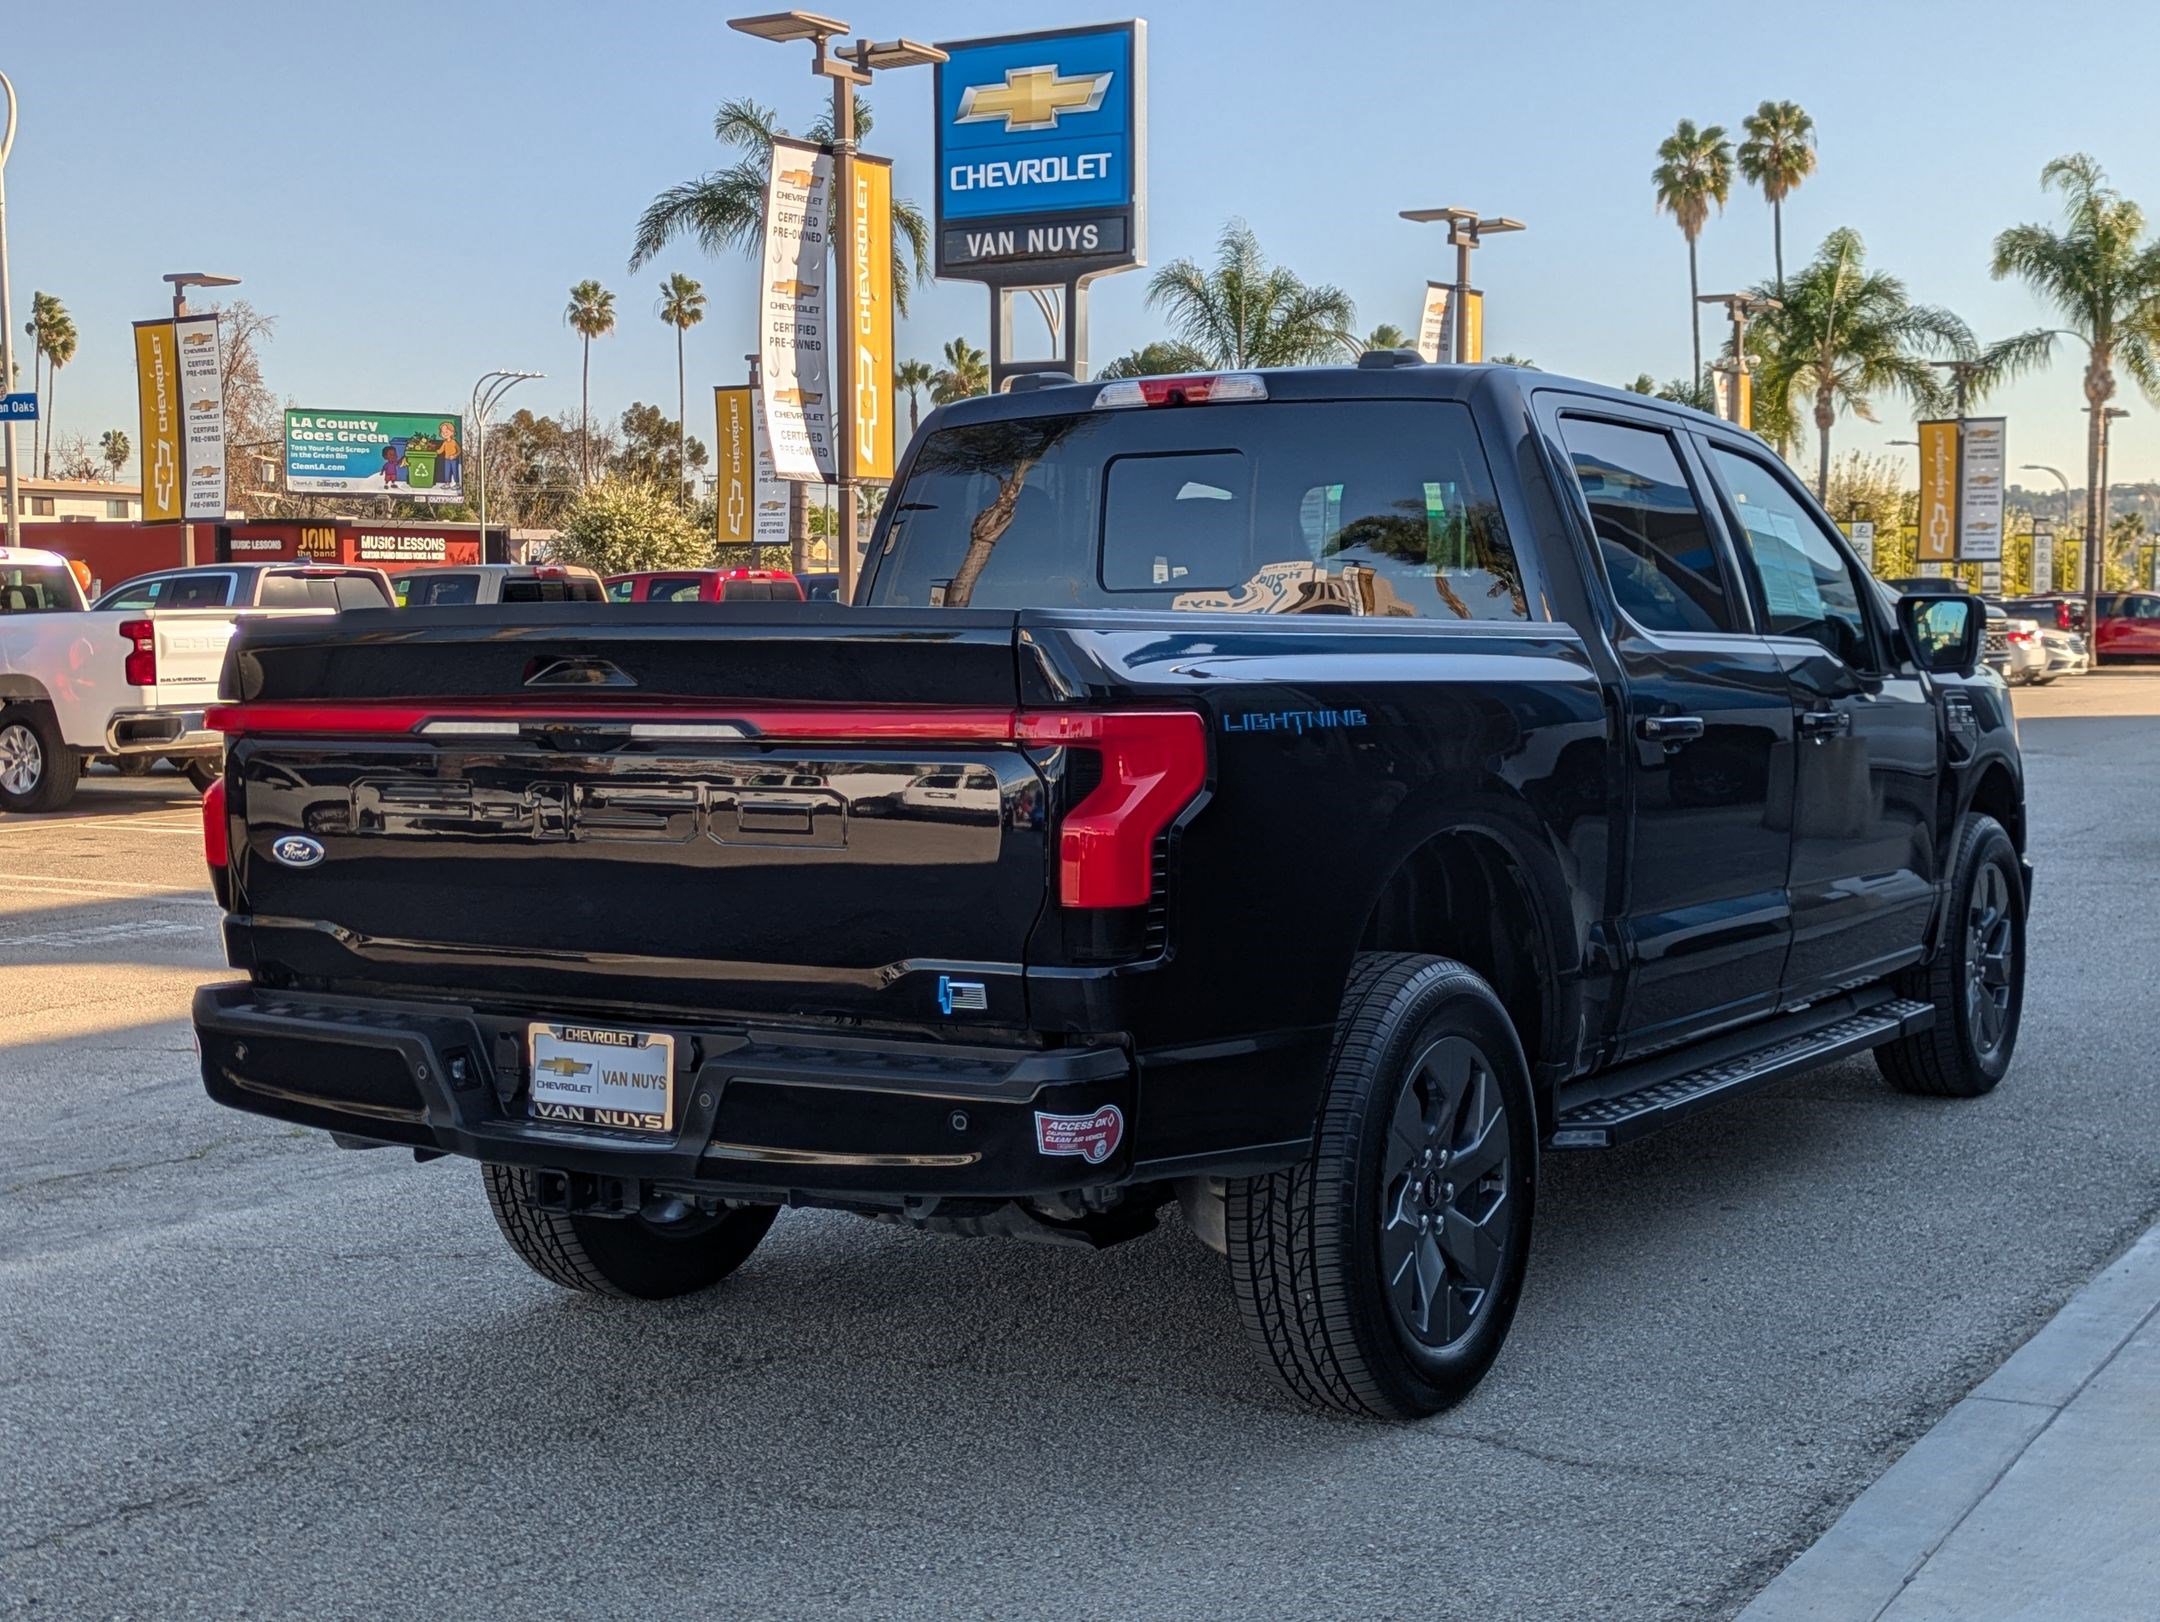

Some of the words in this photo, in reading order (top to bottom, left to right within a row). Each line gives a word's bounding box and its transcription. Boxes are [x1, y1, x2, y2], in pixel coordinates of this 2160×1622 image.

[950, 152, 1112, 191] CHEVROLET
[776, 190, 824, 206] CHEVROLET
[778, 212, 818, 228] CERTIFIED
[773, 226, 822, 243] PRE-OWNED
[966, 230, 1014, 257] VAN
[1028, 224, 1098, 253] NUYS
[857, 175, 871, 336] CHEVROLET
[770, 301, 820, 314] CHEVROLET
[773, 322, 816, 336] CERTIFIED
[183, 346, 215, 354] CHEVROLET
[769, 336, 821, 351] PRE-OWNED
[187, 359, 215, 368] CERTIFIED
[186, 368, 218, 377] PRE-OWNED
[152, 334, 168, 432] CHEVROLET
[12, 400, 35, 413] Oaks
[189, 413, 220, 421] CHEVROLET
[774, 410, 824, 421] CHEVROLET
[192, 425, 219, 433] CERTIFIED
[291, 417, 313, 428] LA
[316, 418, 378, 432] County
[190, 434, 221, 443] PRE-OWNED
[291, 430, 334, 441] Goes
[337, 431, 389, 443] Green
[730, 396, 741, 473] CHEVROLET
[781, 430, 823, 442] CERTIFIED
[291, 463, 346, 472] CleanLA.com
[193, 491, 219, 499] CERTIFIED
[190, 500, 220, 508] PRE-OWNED
[251, 540, 282, 550] LESSONS
[298, 528, 336, 549] JOIN
[361, 536, 396, 550] MUSIC
[398, 536, 446, 551] LESSONS
[1224, 710, 1368, 735] LIGHTNING
[282, 842, 310, 860] Ford
[565, 1029, 635, 1046] CHEVROLET
[536, 1080, 592, 1094] CHEVROLET
[602, 1070, 631, 1087] VAN
[632, 1073, 667, 1090] NUYS
[537, 1103, 584, 1121] VAN
[594, 1109, 663, 1129] NUYS
[1048, 1120, 1094, 1131] ACCESS
[1095, 1118, 1108, 1127] OK
[1085, 1132, 1106, 1141] VEHICLE
